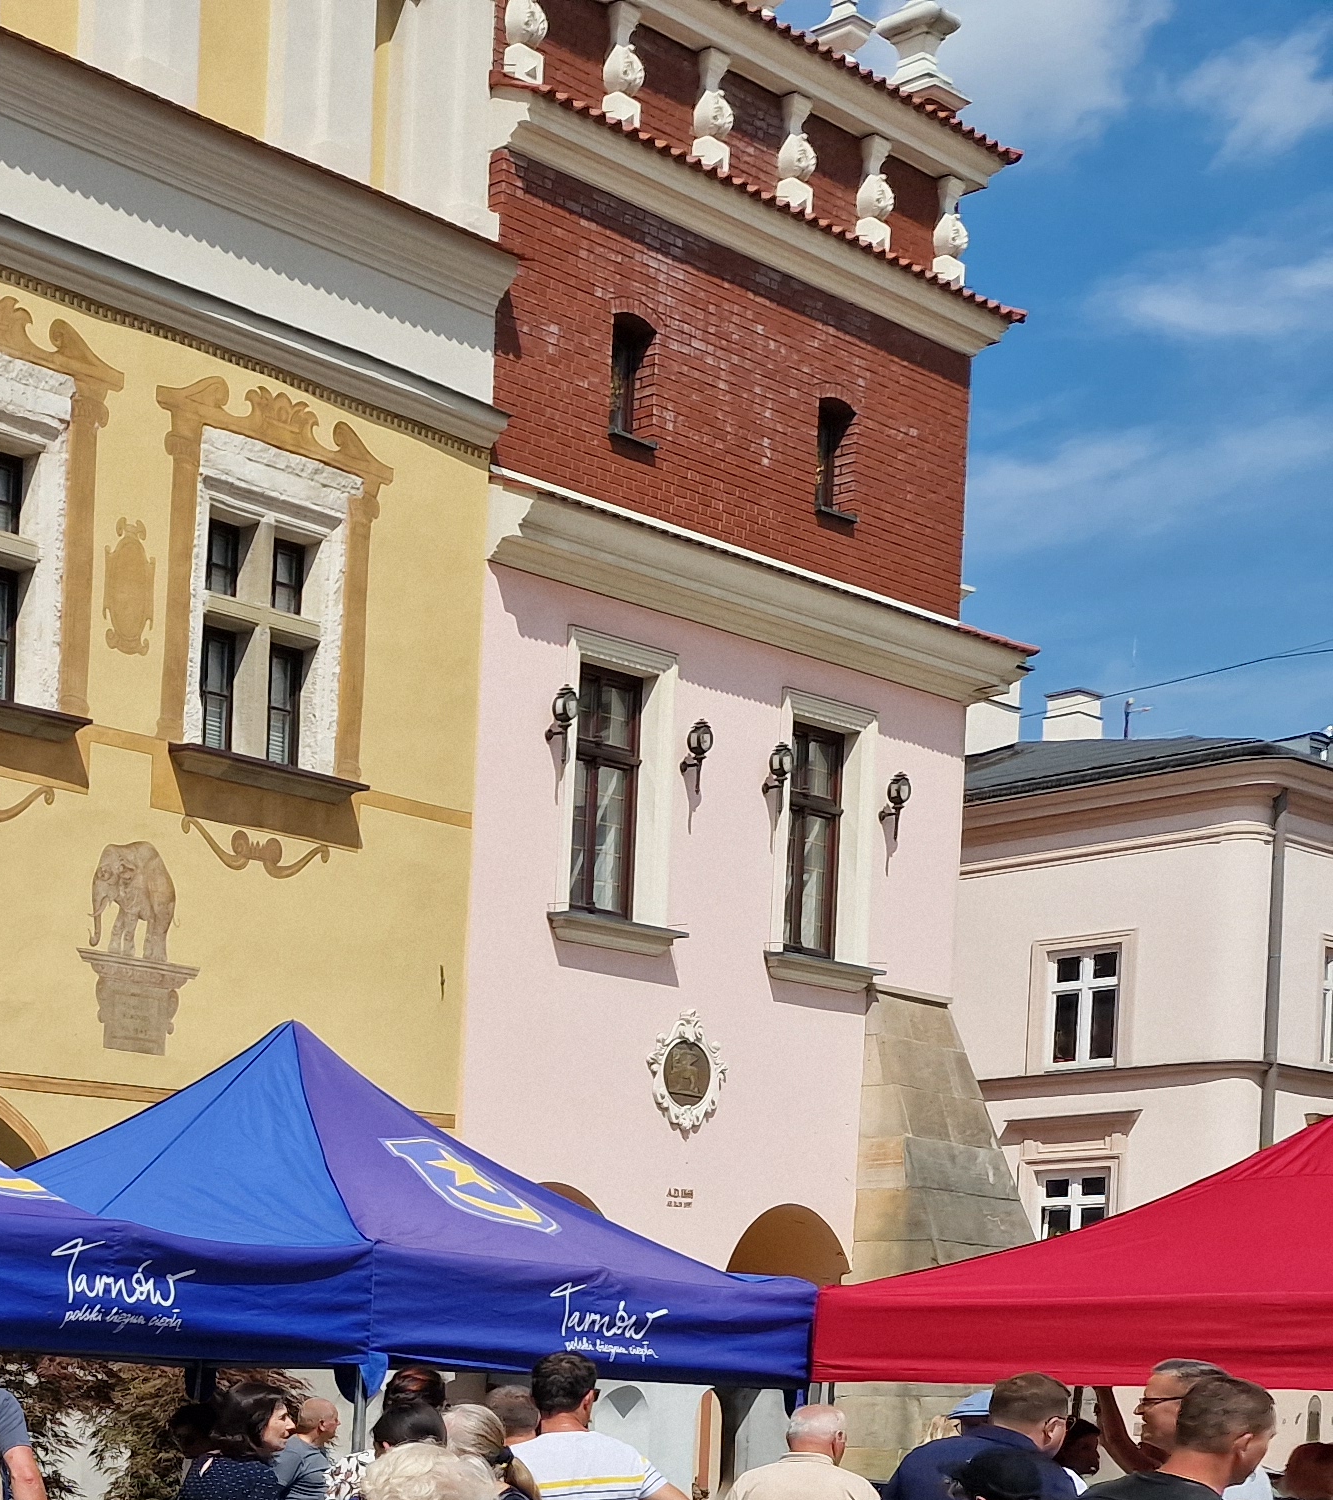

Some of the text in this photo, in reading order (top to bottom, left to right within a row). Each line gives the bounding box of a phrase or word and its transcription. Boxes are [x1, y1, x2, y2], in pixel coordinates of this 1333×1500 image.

[50, 1237, 197, 1307] Tarnów
[59, 1303, 106, 1330] polski
[550, 1281, 669, 1340] Tarnów
